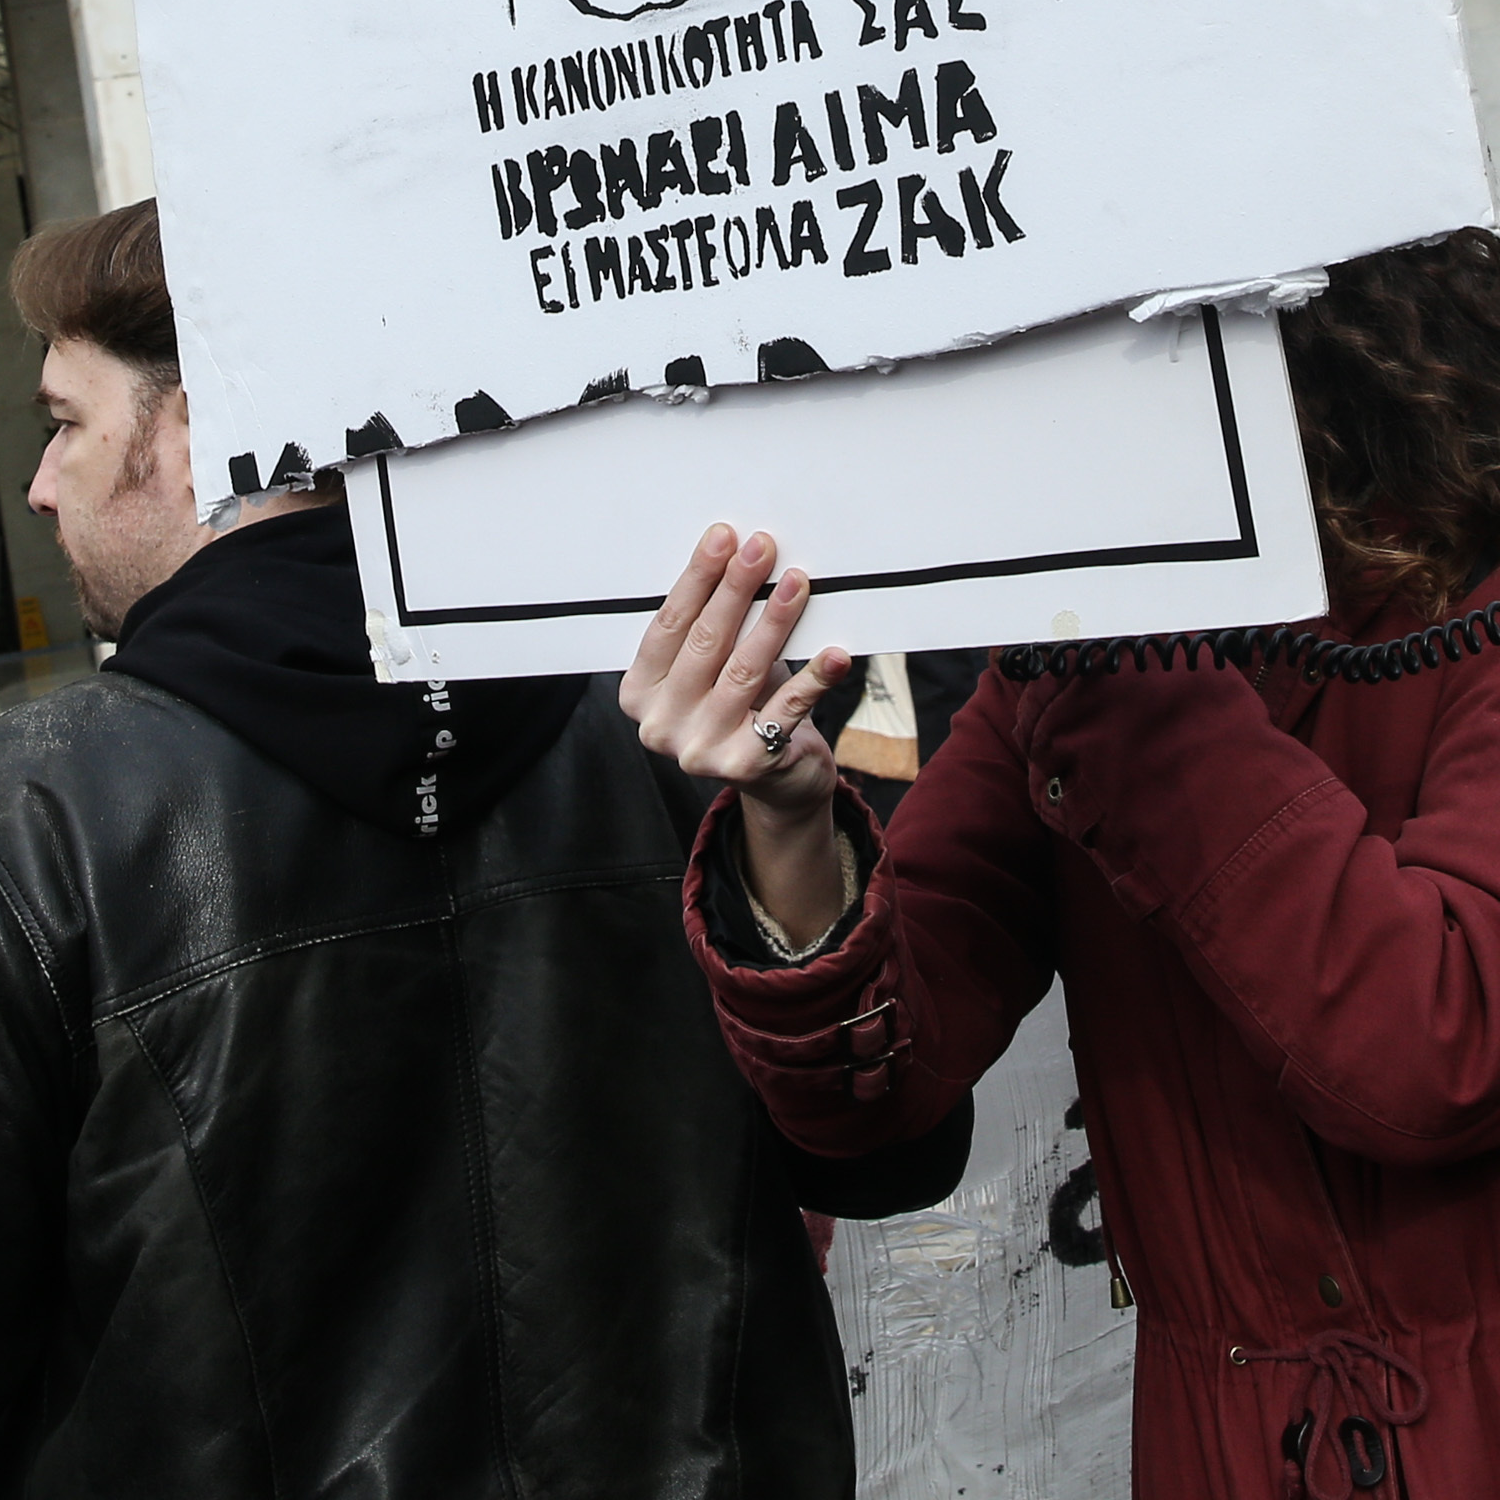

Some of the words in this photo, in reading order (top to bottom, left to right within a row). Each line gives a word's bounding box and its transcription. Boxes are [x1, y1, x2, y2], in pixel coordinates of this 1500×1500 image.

[472, 70, 503, 133] Η
[512, 0, 823, 125] ΚΑΝΟΝΙΚΟΤΗΤΑ
[772, 59, 997, 184] ΑΙΜΑ
[836, 148, 1026, 278] ΖΑΚ
